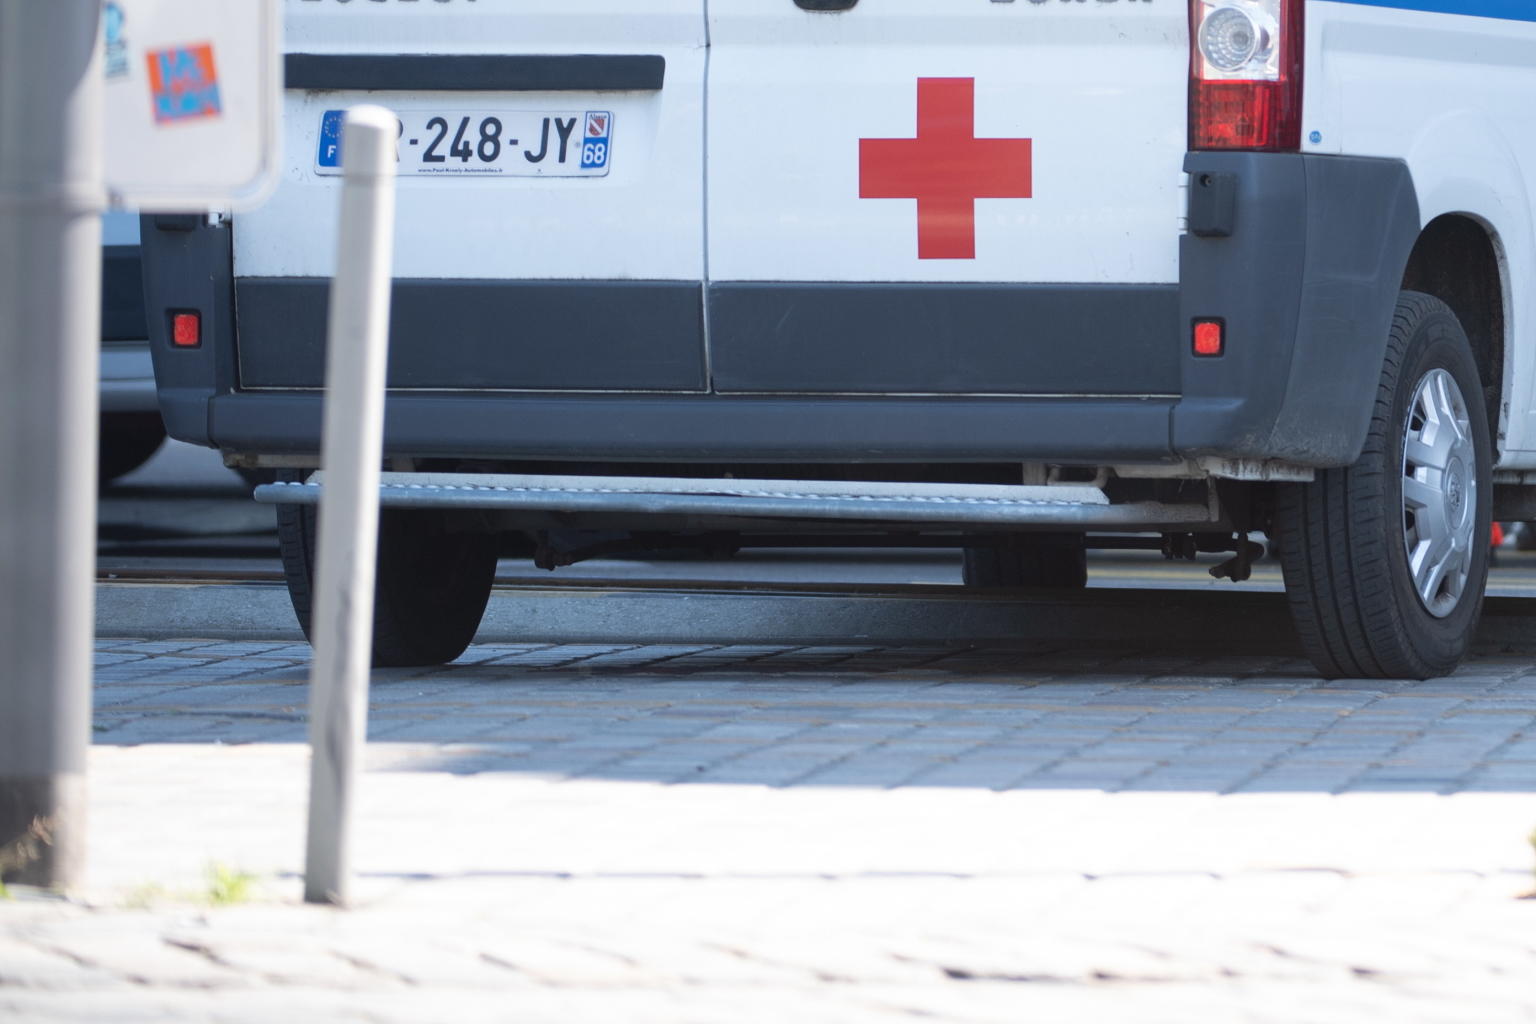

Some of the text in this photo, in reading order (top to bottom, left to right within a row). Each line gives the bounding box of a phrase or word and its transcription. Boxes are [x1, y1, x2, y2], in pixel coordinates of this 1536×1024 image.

[327, 116, 605, 164] F -248-JY 68
